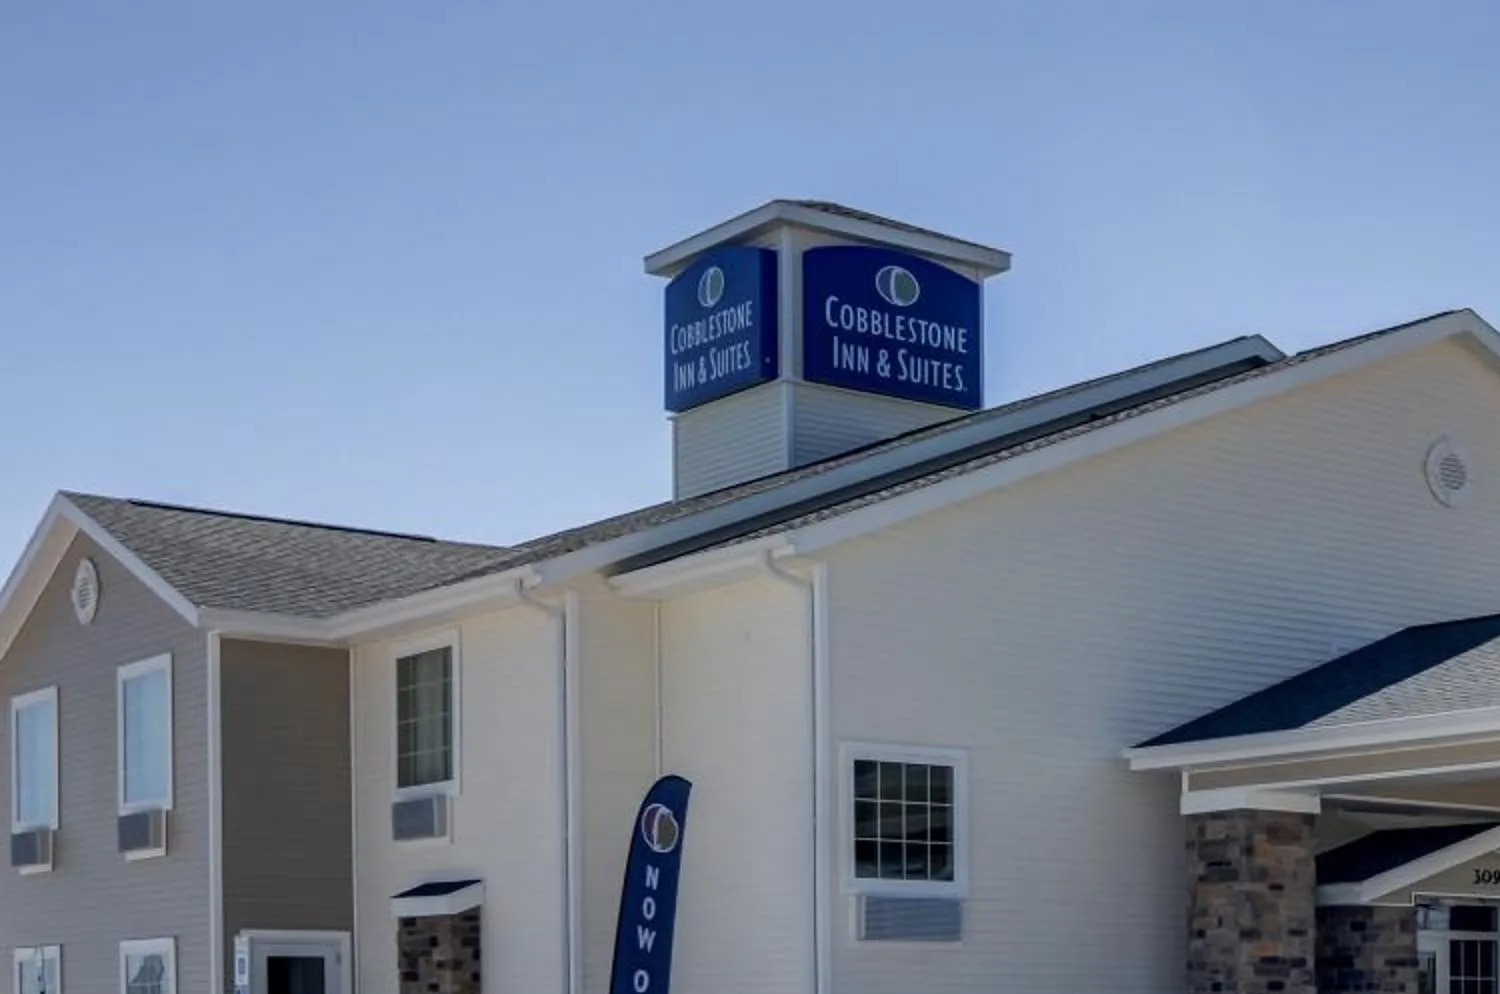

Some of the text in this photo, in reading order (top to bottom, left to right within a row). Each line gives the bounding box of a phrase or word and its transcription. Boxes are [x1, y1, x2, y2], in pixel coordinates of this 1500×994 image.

[671, 300, 752, 355] COBBLESTONE
[824, 295, 968, 353] COBBLESTONE
[673, 340, 751, 392] INN & SUITES
[832, 335, 964, 392] INN & SUITES
[636, 864, 660, 954] NOW
